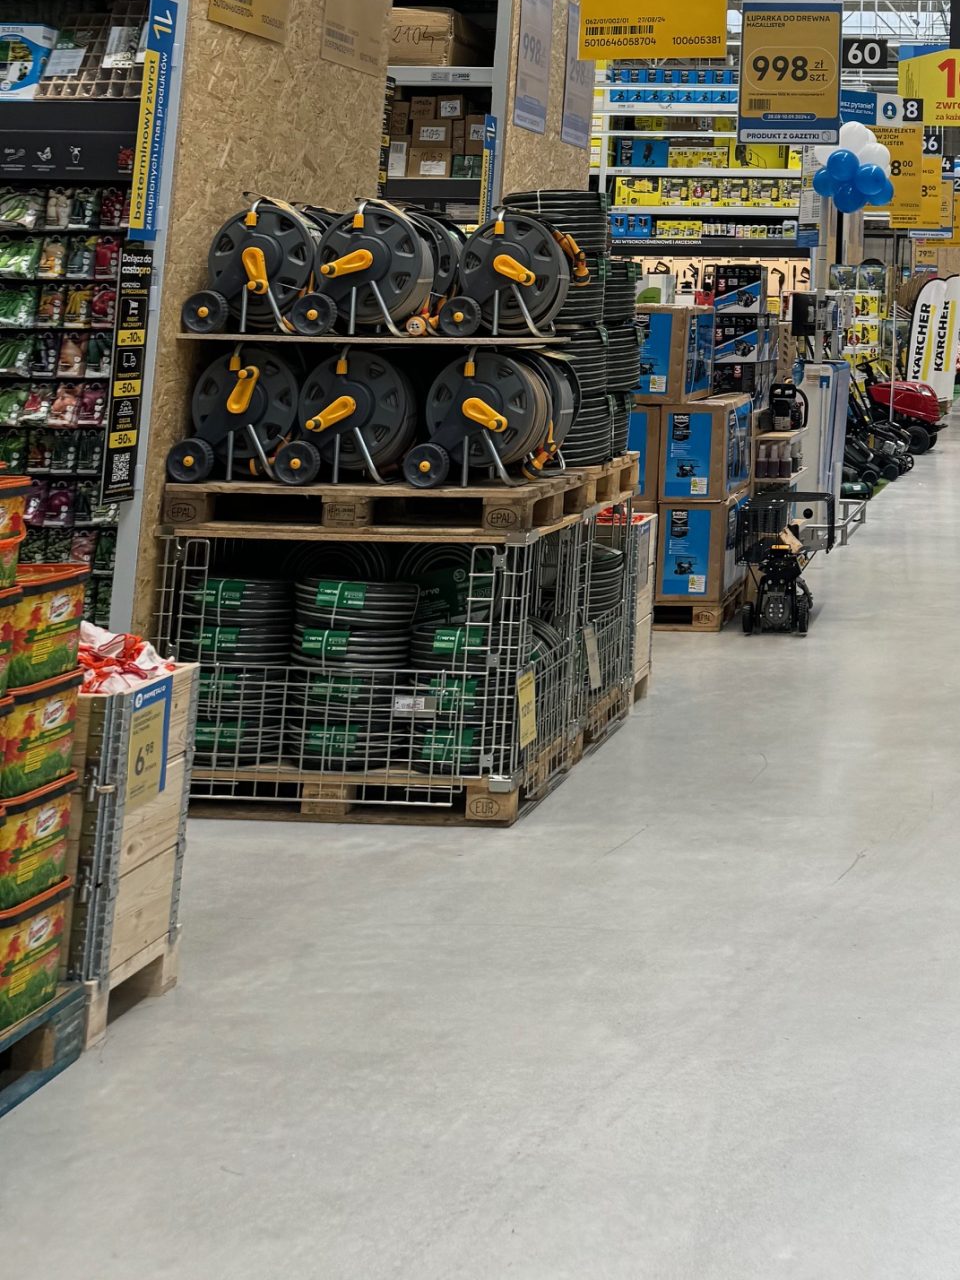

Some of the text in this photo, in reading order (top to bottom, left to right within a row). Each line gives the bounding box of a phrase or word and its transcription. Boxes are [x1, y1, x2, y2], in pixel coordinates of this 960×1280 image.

[584, 35, 721, 48] 5010646058704 100605381
[848, 43, 881, 65] 60
[753, 56, 828, 82] 998 zł szt.
[133, 59, 156, 220] bezterminowy zwrot
[146, 153, 158, 230] zakupionych
[157, 52, 168, 117] produktów
[122, 253, 152, 264] Dołącz do
[135, 746, 145, 776] 6
[474, 801, 496, 815] EUR
